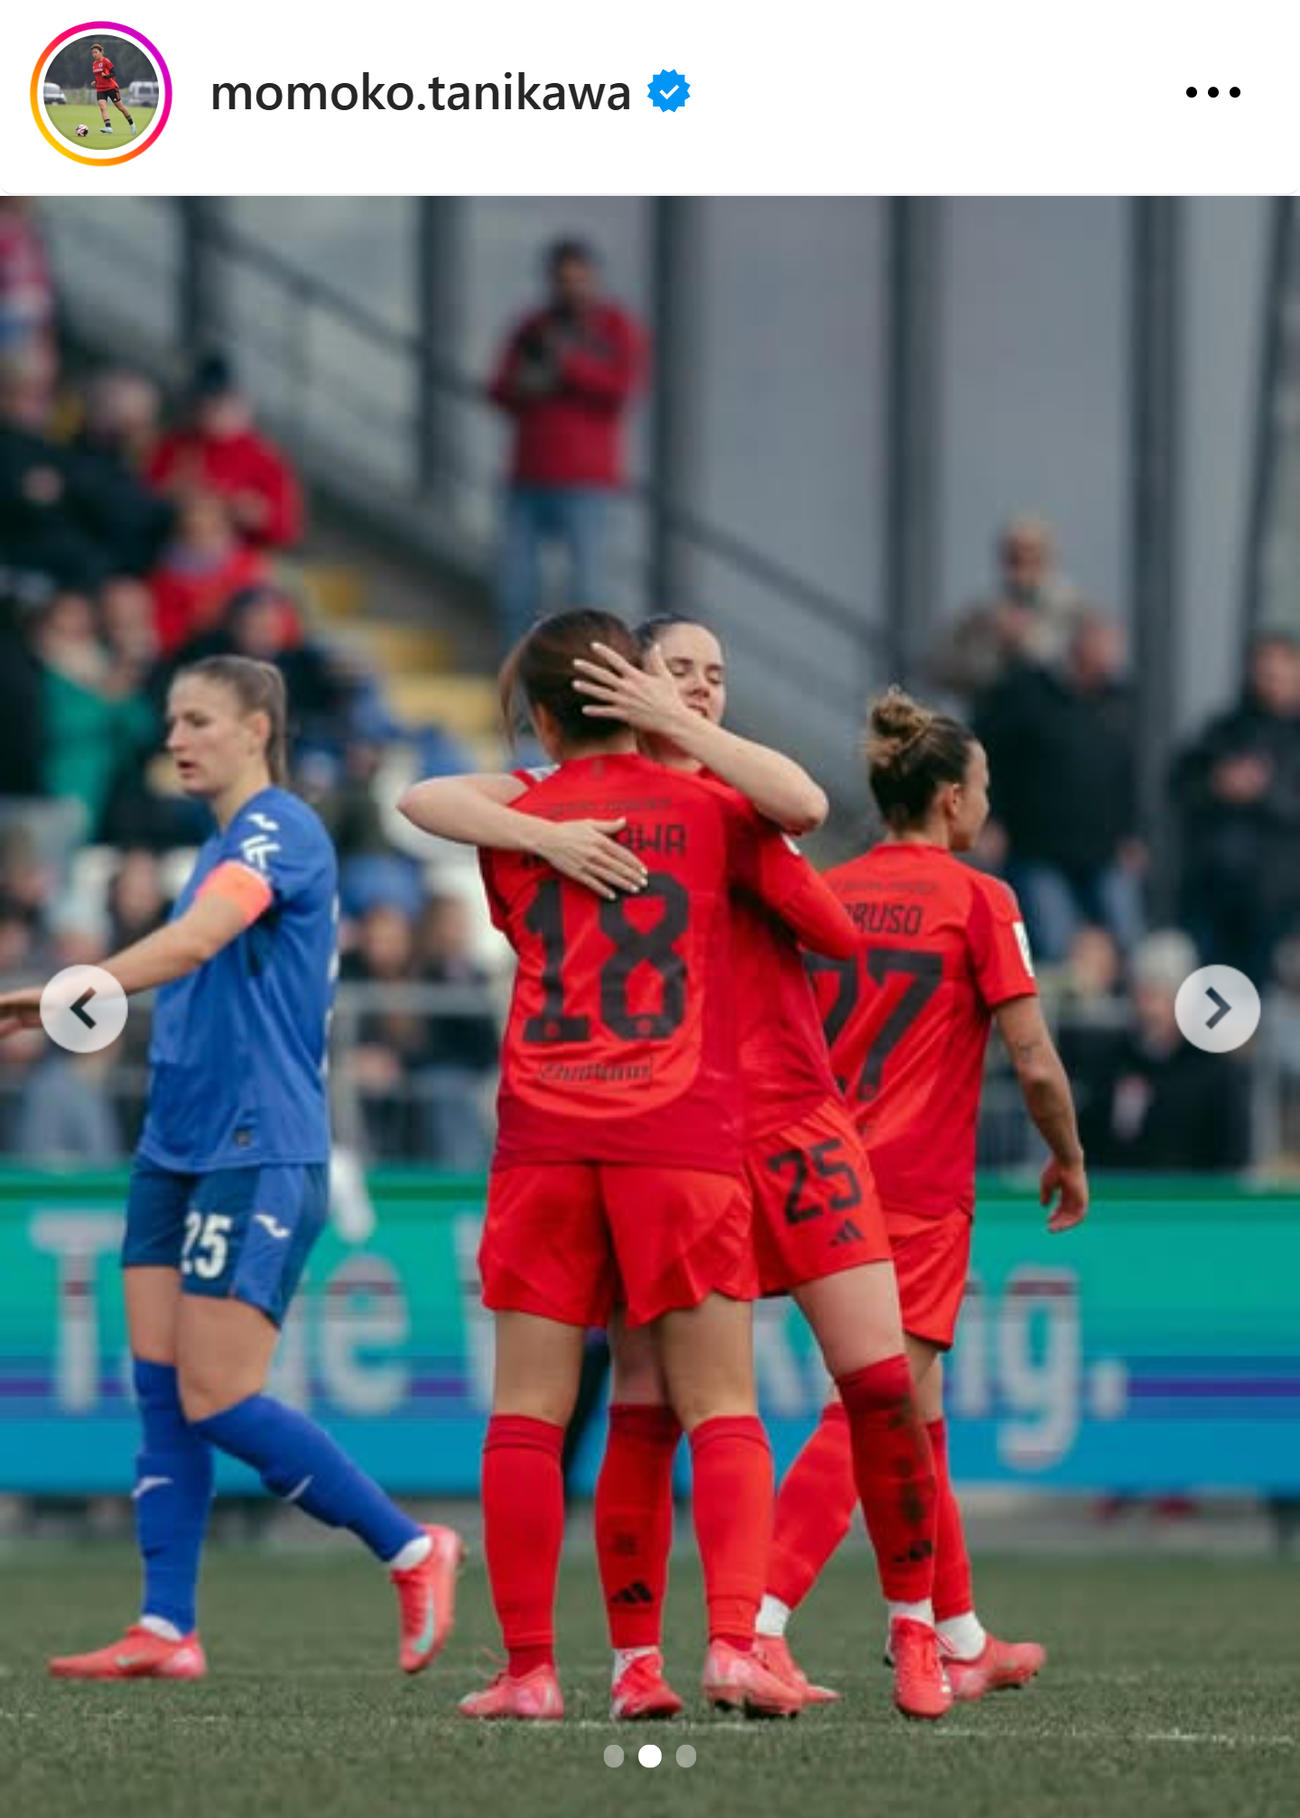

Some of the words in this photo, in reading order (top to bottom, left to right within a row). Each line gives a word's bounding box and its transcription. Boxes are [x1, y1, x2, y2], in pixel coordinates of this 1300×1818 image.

[522, 872, 690, 1043] 18
[843, 901, 924, 937] RUSO
[767, 1138, 862, 1226] 25
